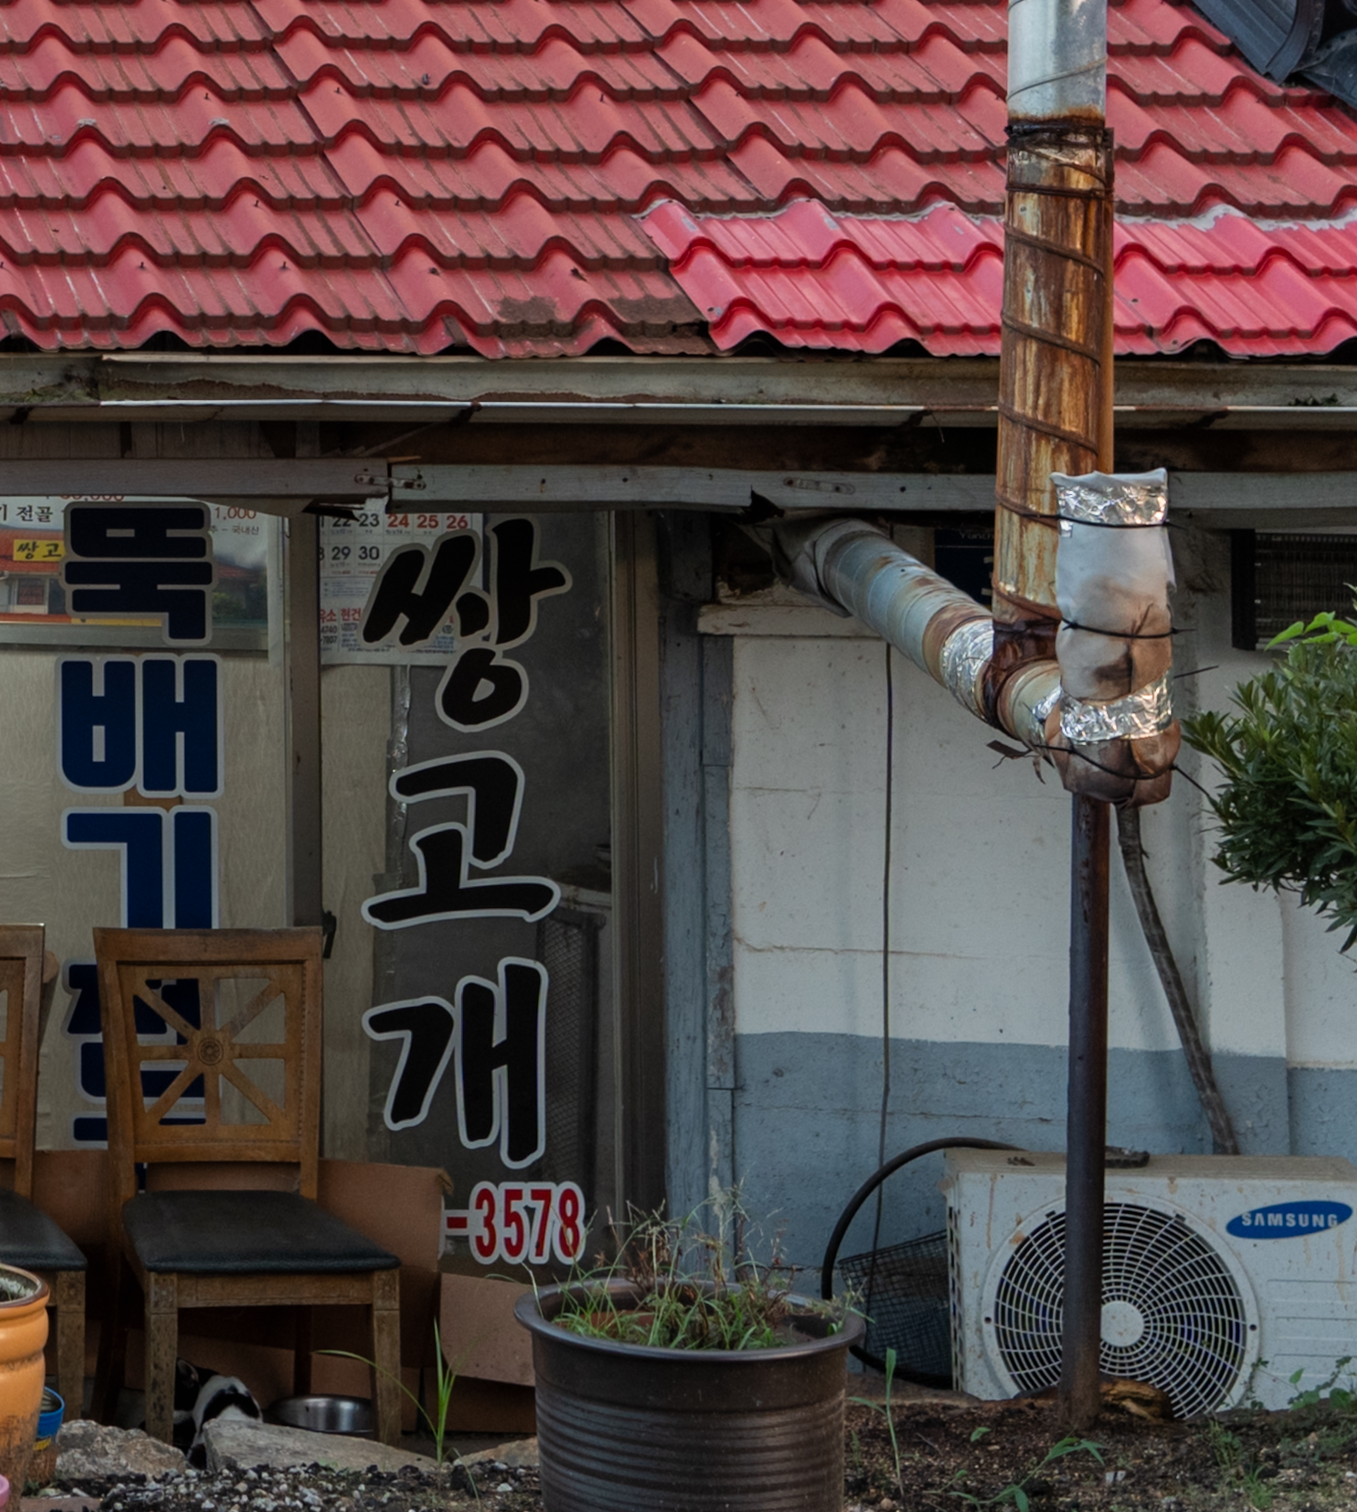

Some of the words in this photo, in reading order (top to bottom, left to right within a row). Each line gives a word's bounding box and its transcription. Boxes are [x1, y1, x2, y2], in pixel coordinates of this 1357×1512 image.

[16, 505, 53, 523] 전골
[359, 513, 380, 527] 23
[387, 514, 410, 528] 24
[417, 515, 439, 529] 25
[446, 515, 468, 529] 26
[17, 541, 62, 560] 쌍고
[331, 546, 351, 560] 29
[358, 546, 380, 560] 30
[360, 515, 574, 1170] 쌍고개
[437, 1181, 586, 1265] -3578
[1241, 1212, 1338, 1228] SAMSUNG
